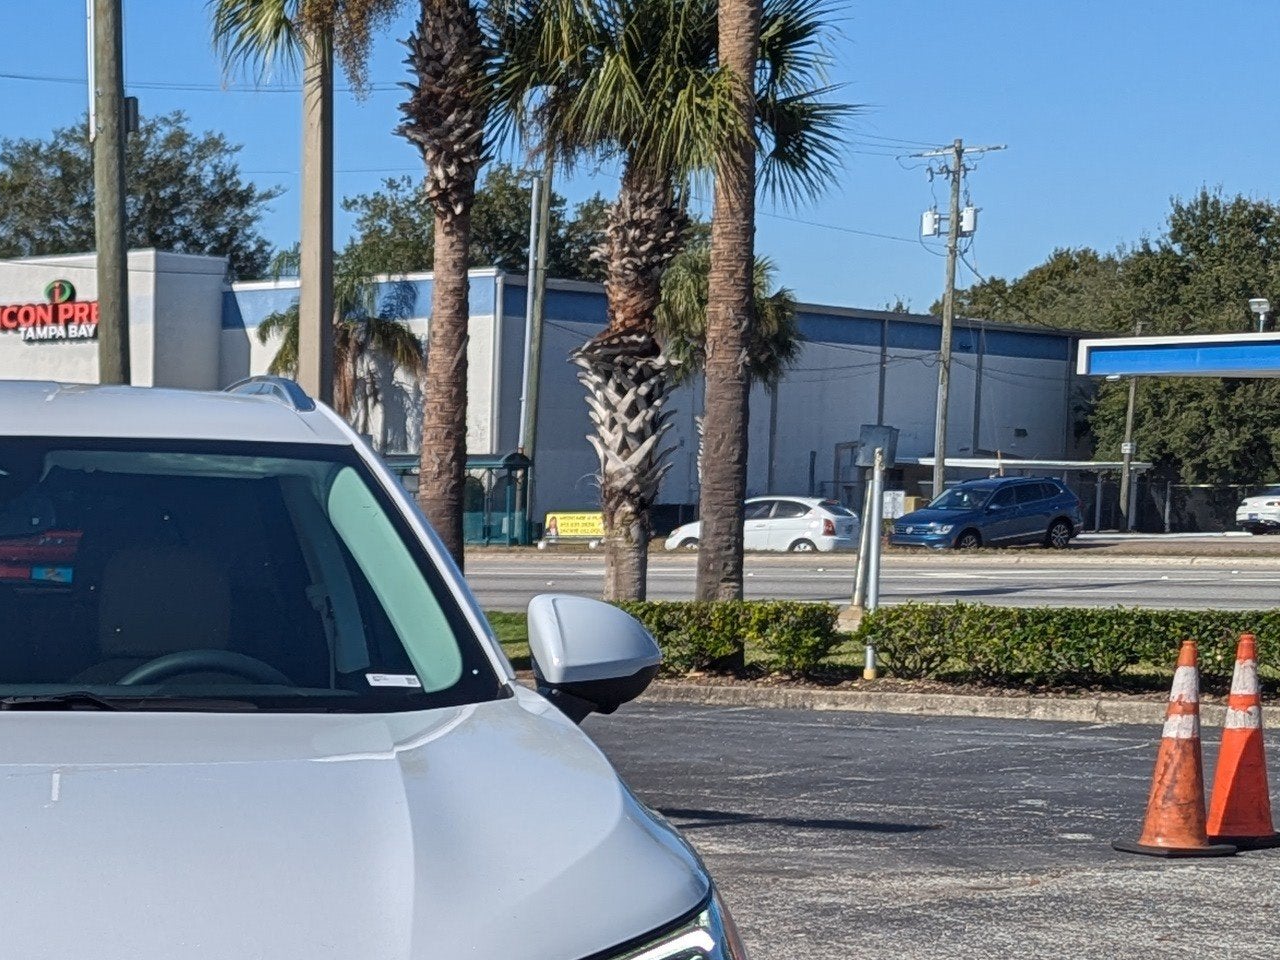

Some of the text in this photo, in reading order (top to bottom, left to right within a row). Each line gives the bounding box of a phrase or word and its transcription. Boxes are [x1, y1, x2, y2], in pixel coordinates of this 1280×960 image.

[59, 301, 99, 325] PRE
[20, 323, 96, 340] TAMPA BAY
